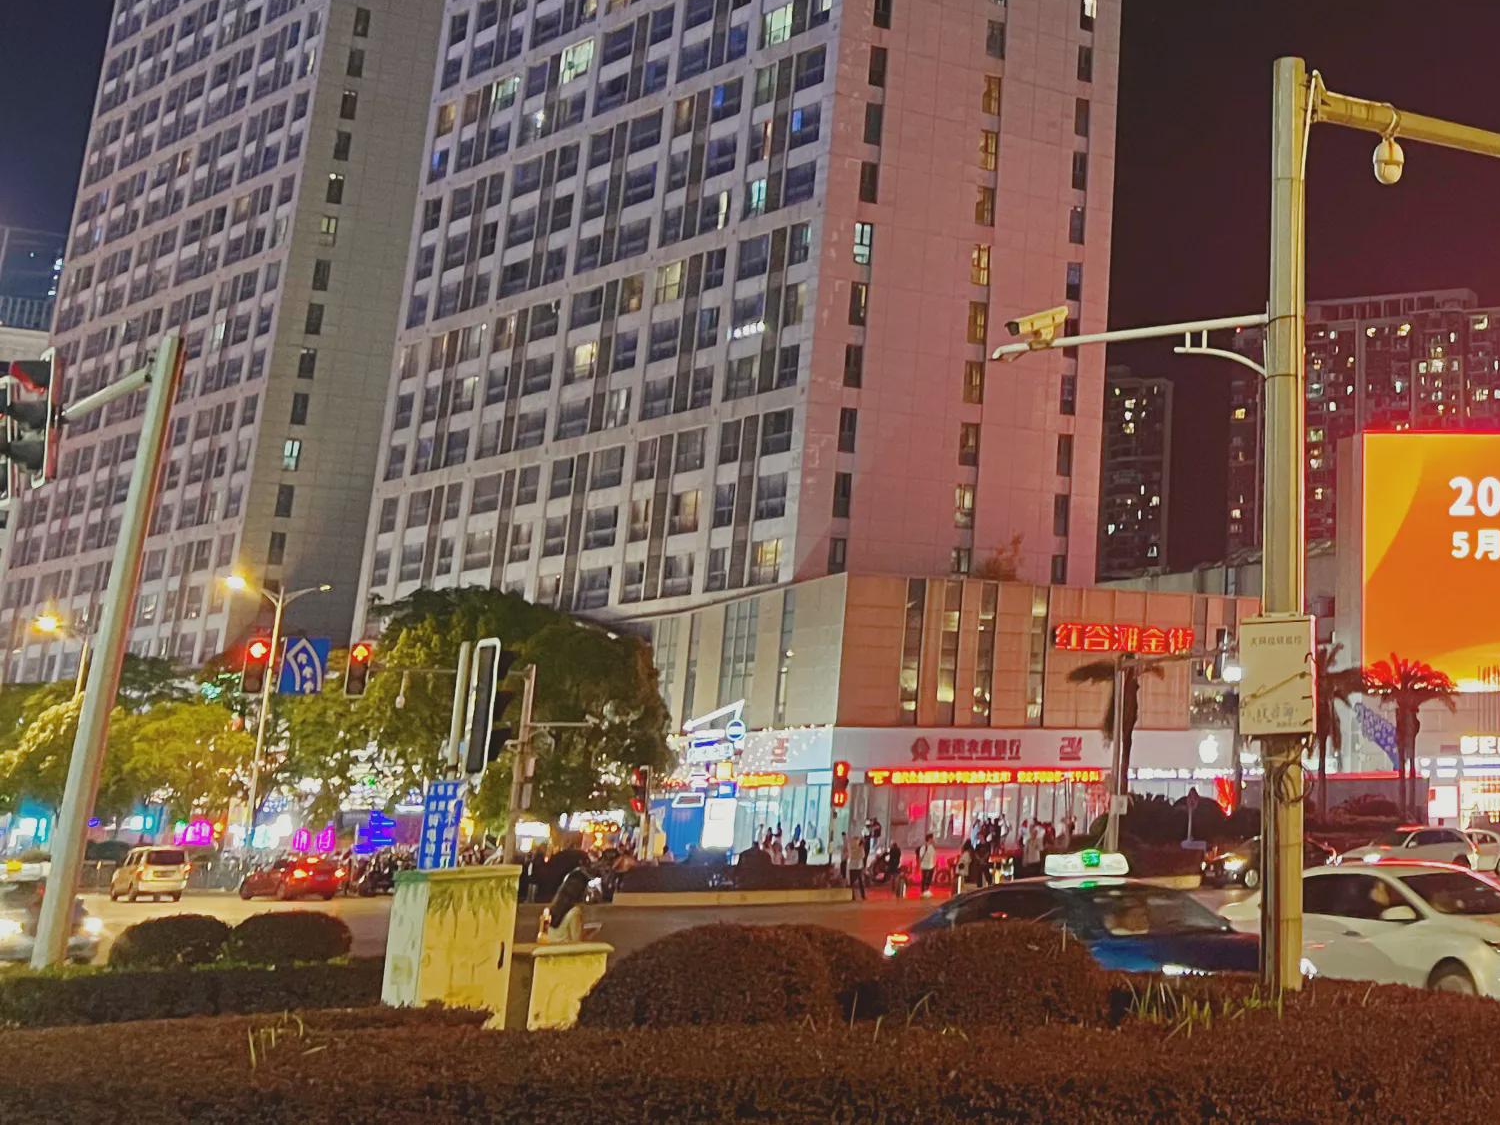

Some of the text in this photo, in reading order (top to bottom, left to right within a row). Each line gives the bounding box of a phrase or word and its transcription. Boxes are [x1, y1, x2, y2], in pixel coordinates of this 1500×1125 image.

[1055, 624, 1193, 654] 红谷滩金街
